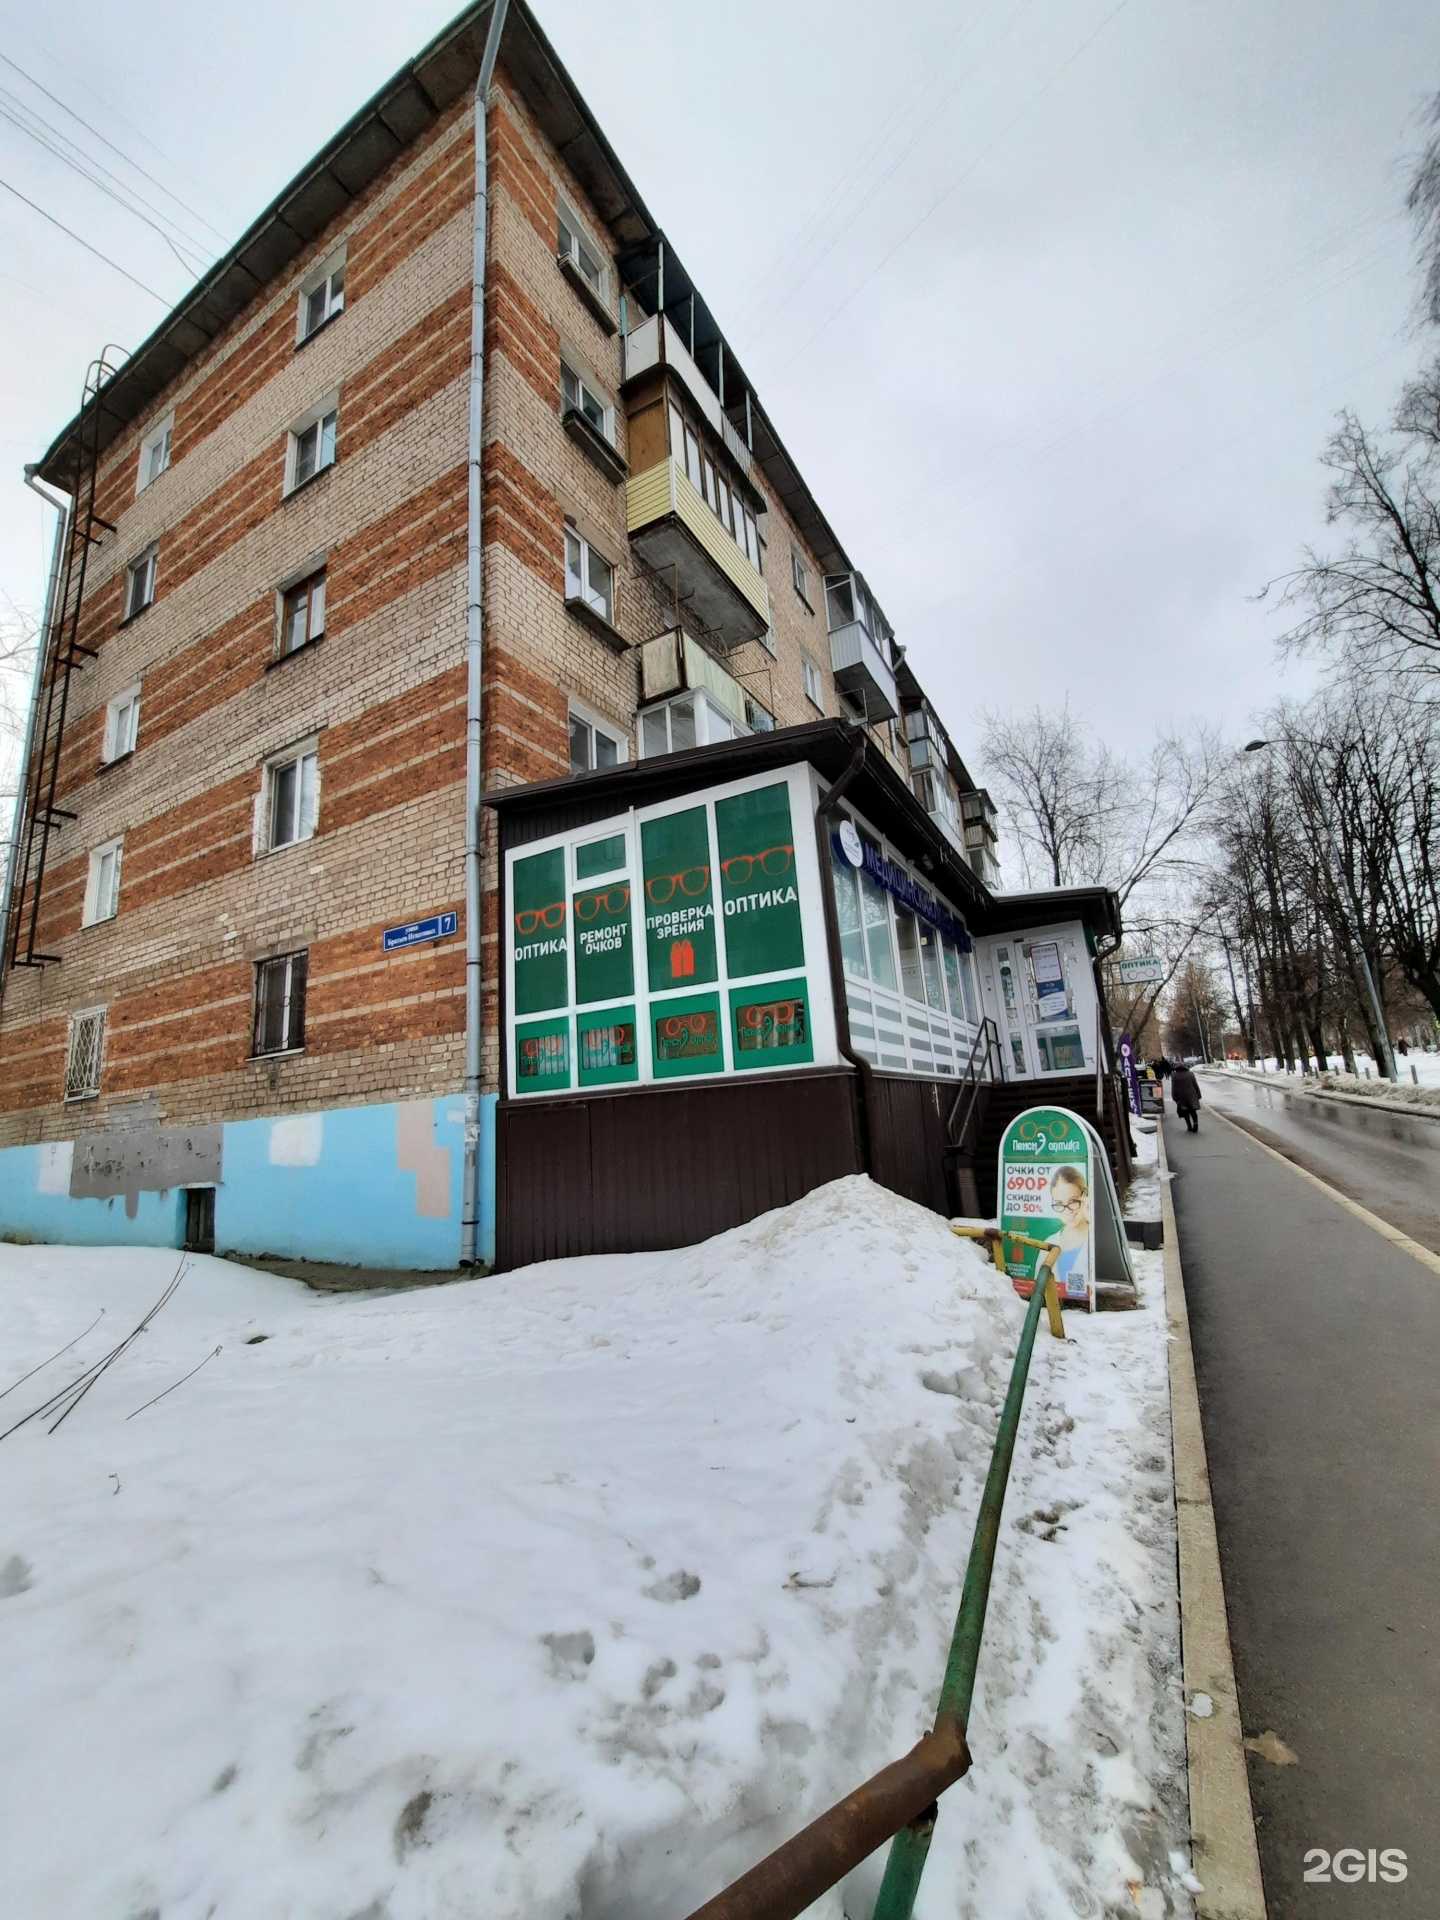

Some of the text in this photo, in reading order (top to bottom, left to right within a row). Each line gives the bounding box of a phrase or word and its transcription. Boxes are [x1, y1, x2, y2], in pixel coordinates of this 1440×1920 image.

[726, 886, 798, 916] ОПТИКА
[444, 917, 452, 931] 7
[646, 904, 714, 930] ПРОВЕРКА
[580, 923, 628, 944] РЕМОНТ
[656, 919, 705, 940] ЗРЕНИЯ
[515, 937, 568, 961] ОПТИКА
[585, 937, 622, 955] ОЧКОВ
[1121, 960, 1159, 969] ОПТИКА
[1006, 1166, 1051, 1175] ОЧКИ ОТ
[1006, 1193, 1041, 1202] СКИДКИ
[1006, 1202, 1021, 1212] ДО
